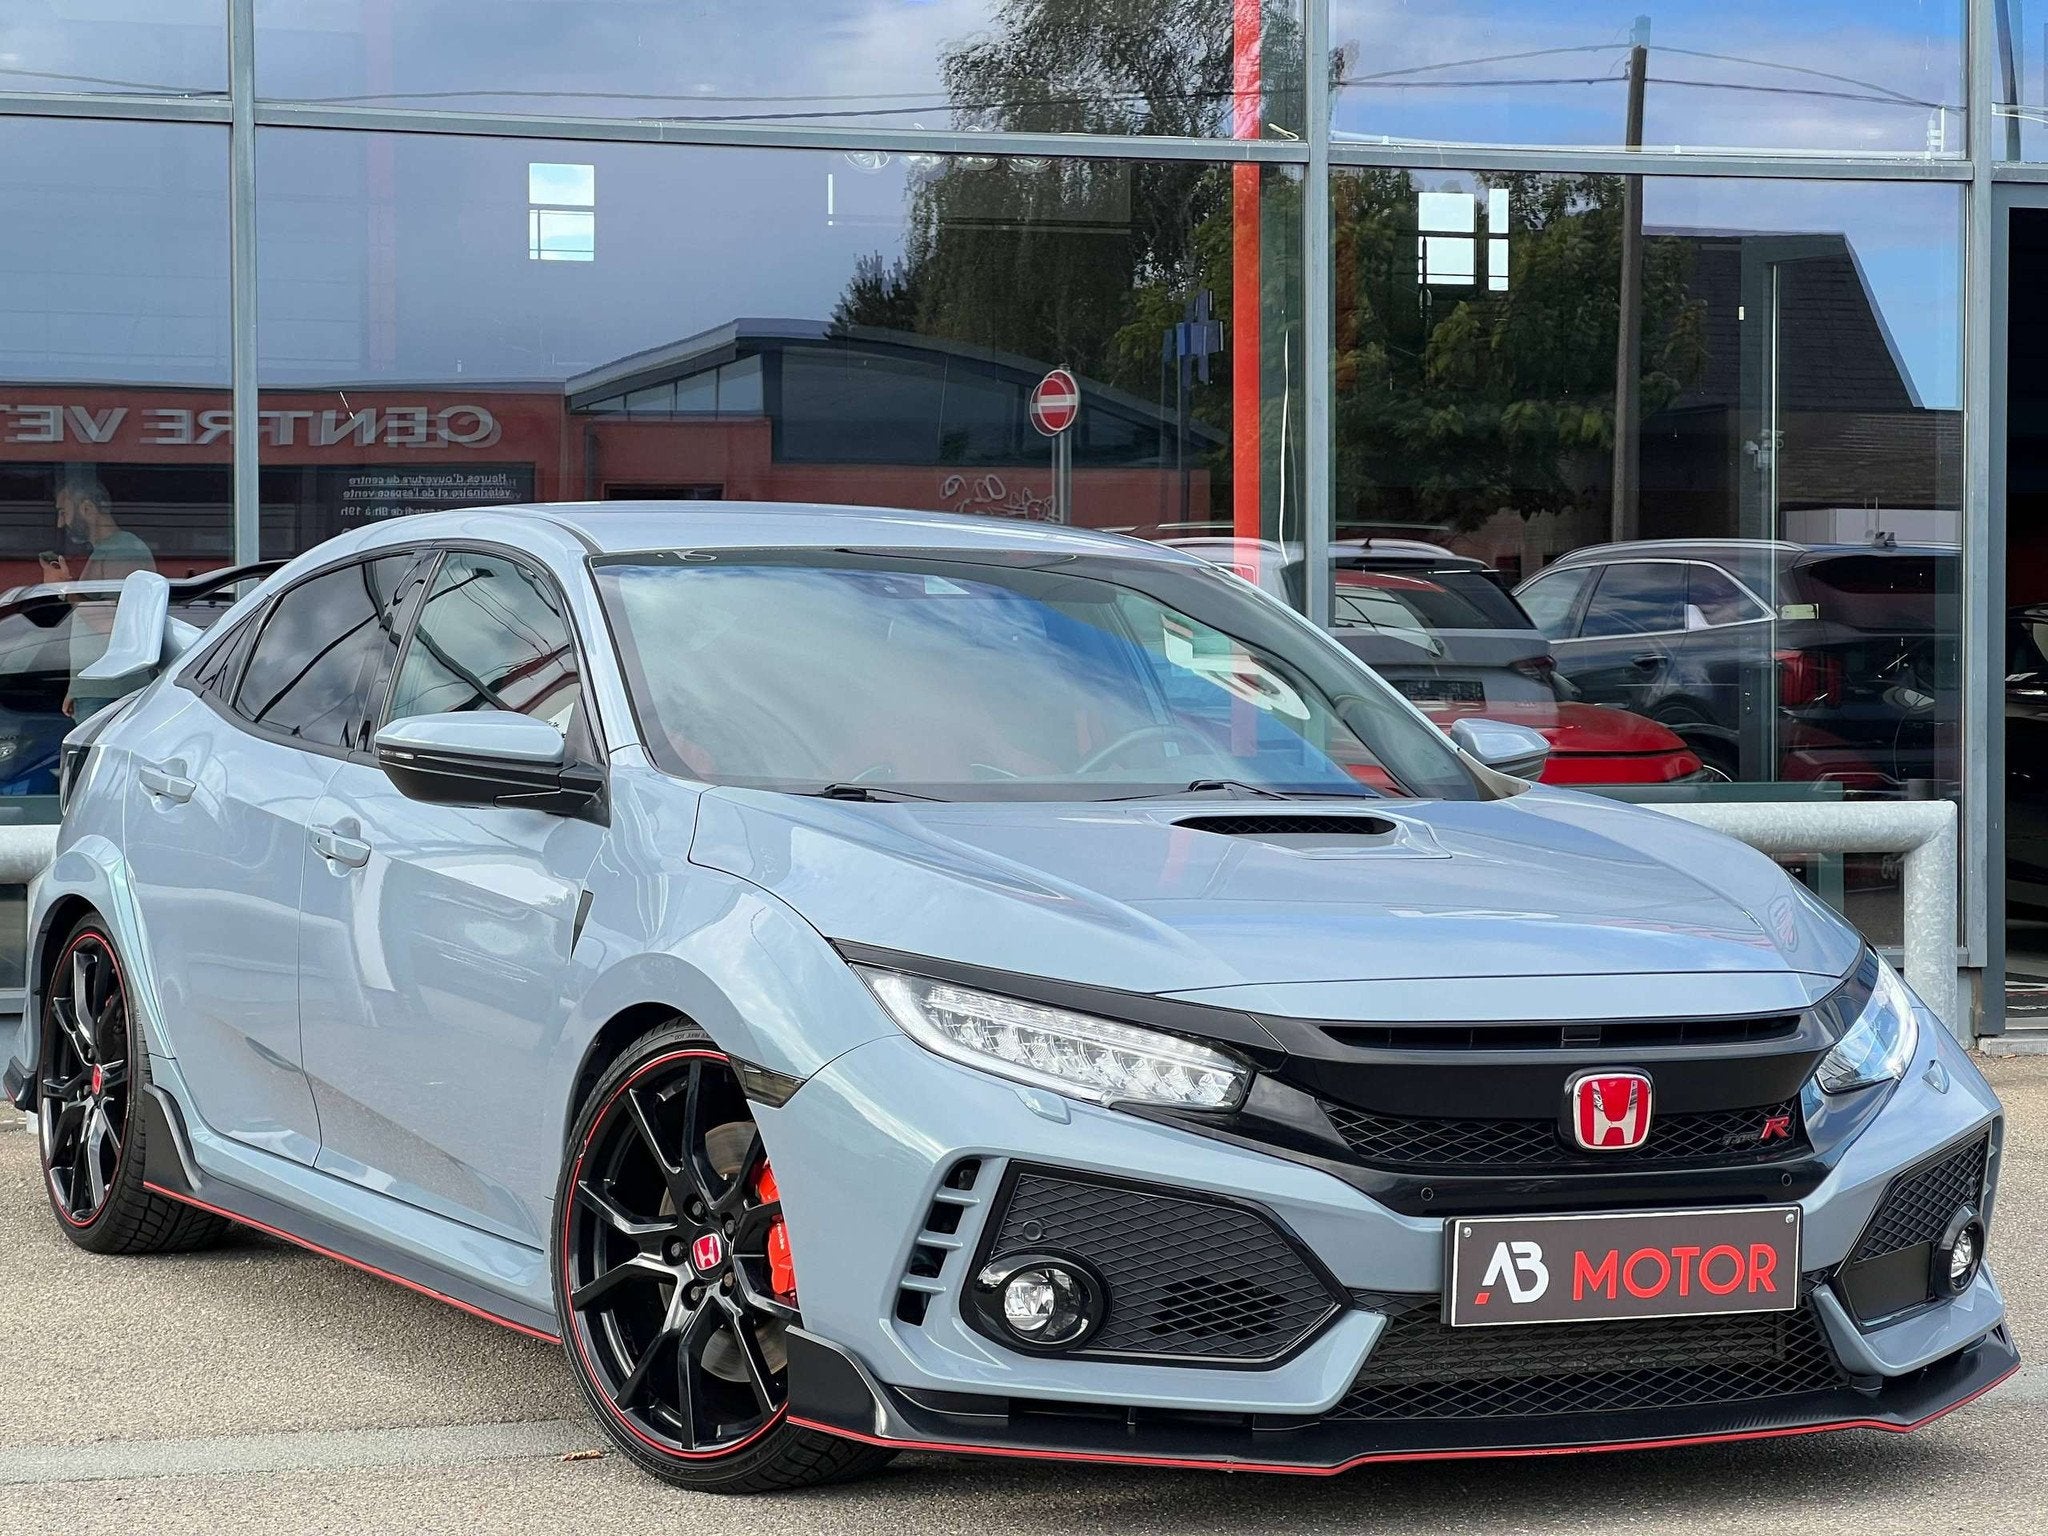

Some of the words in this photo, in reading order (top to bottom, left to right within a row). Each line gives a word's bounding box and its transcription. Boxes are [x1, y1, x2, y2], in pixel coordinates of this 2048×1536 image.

[1759, 1113, 1791, 1141] R
[1475, 1241, 1550, 1305] AB
[1573, 1243, 1778, 1301] MOTOR
